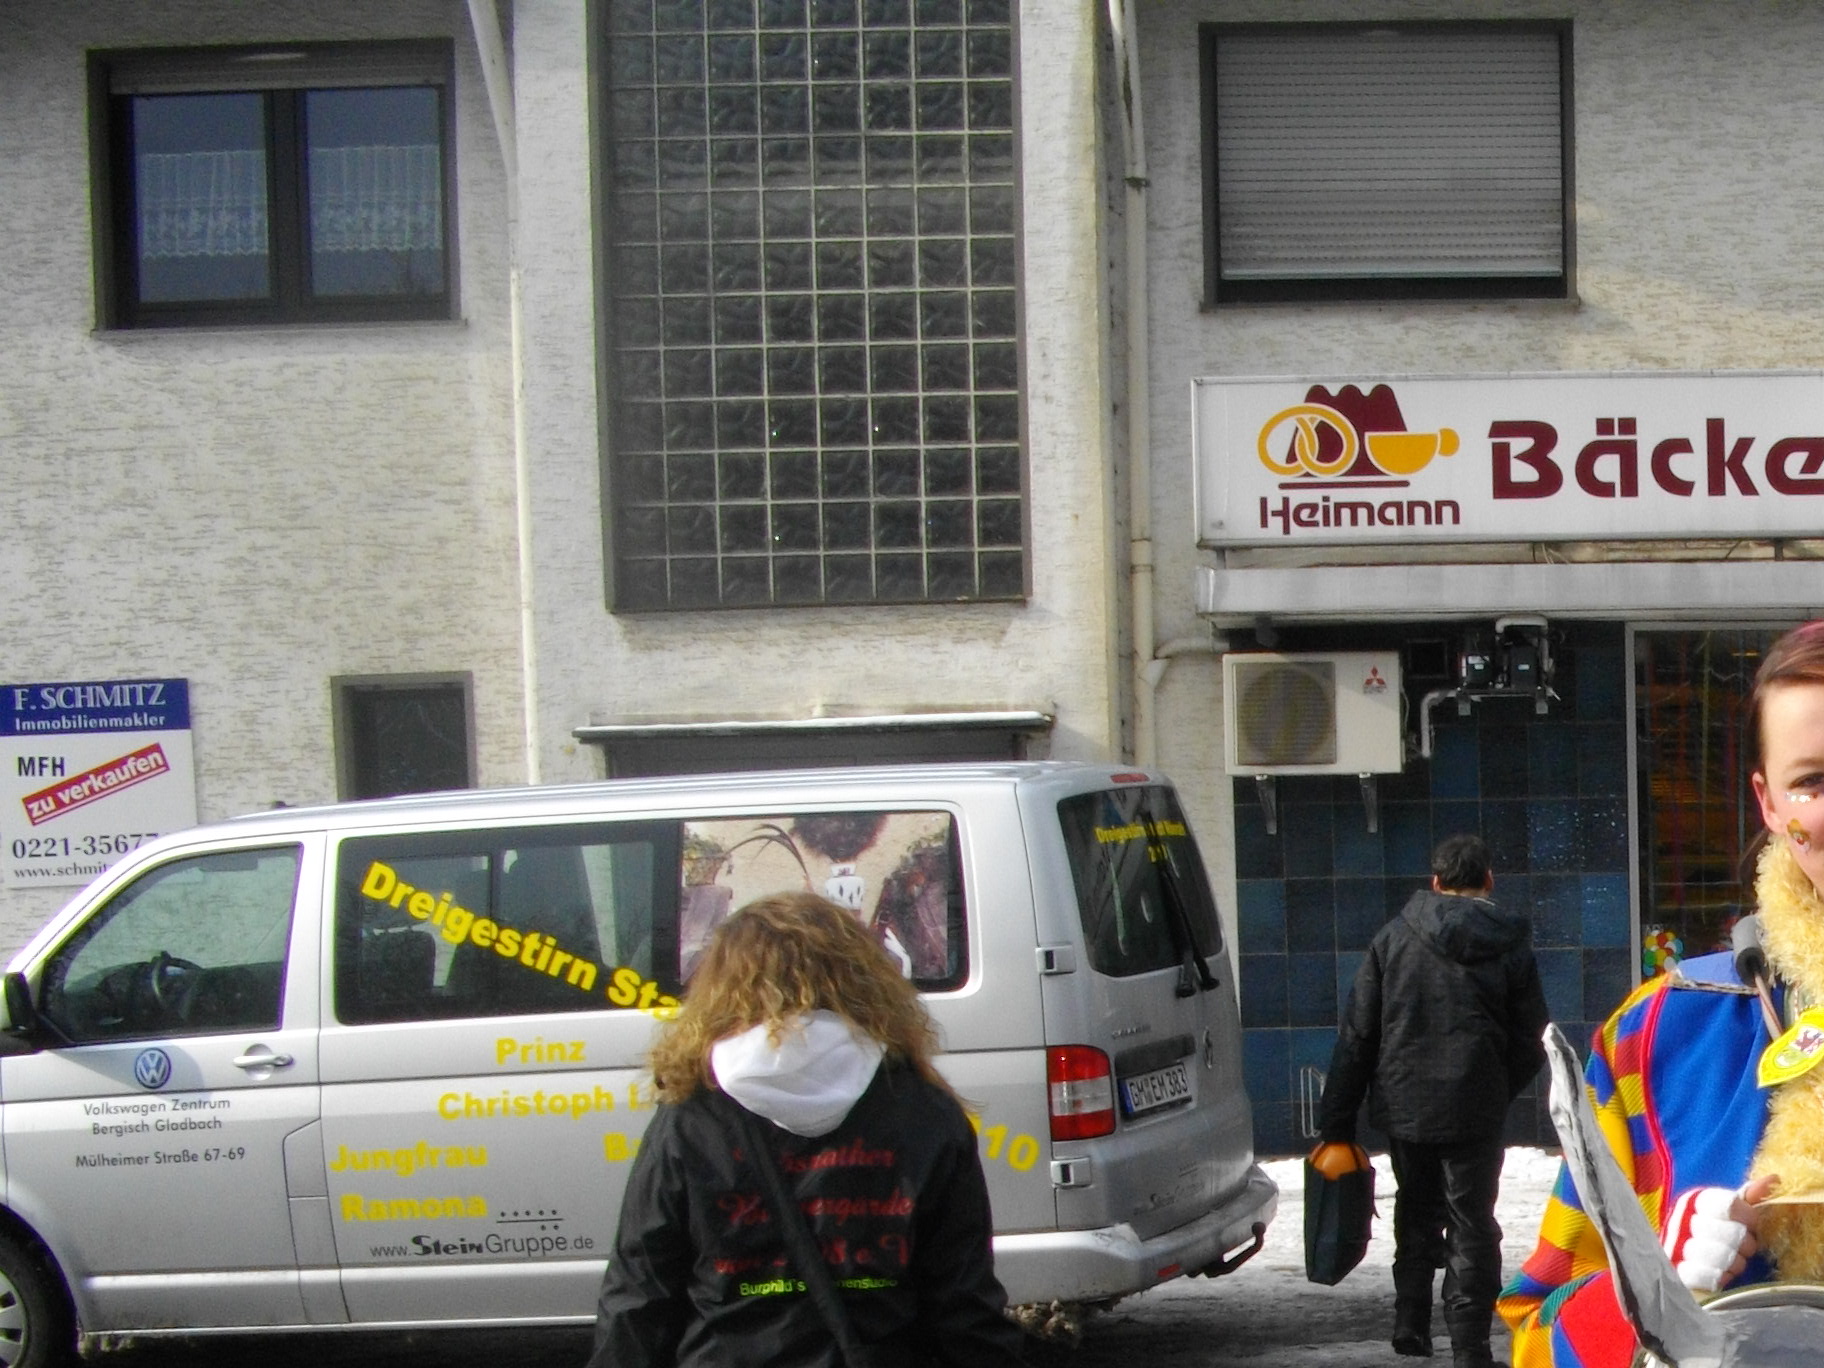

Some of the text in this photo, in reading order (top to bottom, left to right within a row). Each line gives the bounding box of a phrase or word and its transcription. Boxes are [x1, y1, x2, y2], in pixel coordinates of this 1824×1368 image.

[1259, 496, 1461, 536] Heimann
[14, 682, 166, 711] F. SCHMITZ
[15, 711, 166, 732] Immobilienmakler
[17, 755, 66, 778] MFH
[27, 750, 165, 819] zu verkaufen
[361, 859, 681, 1020] Dreigestirn Sta
[495, 1036, 586, 1066] Prinz
[83, 1097, 231, 1118] Volkswagen Zentrum
[437, 1084, 615, 1121] Christoph
[91, 1116, 222, 1137] Bergisch Gladbach
[75, 1146, 246, 1168] Mülheimer Straße 67-69
[329, 1140, 488, 1178] Jungfrau
[340, 1194, 488, 1222] Ramona
